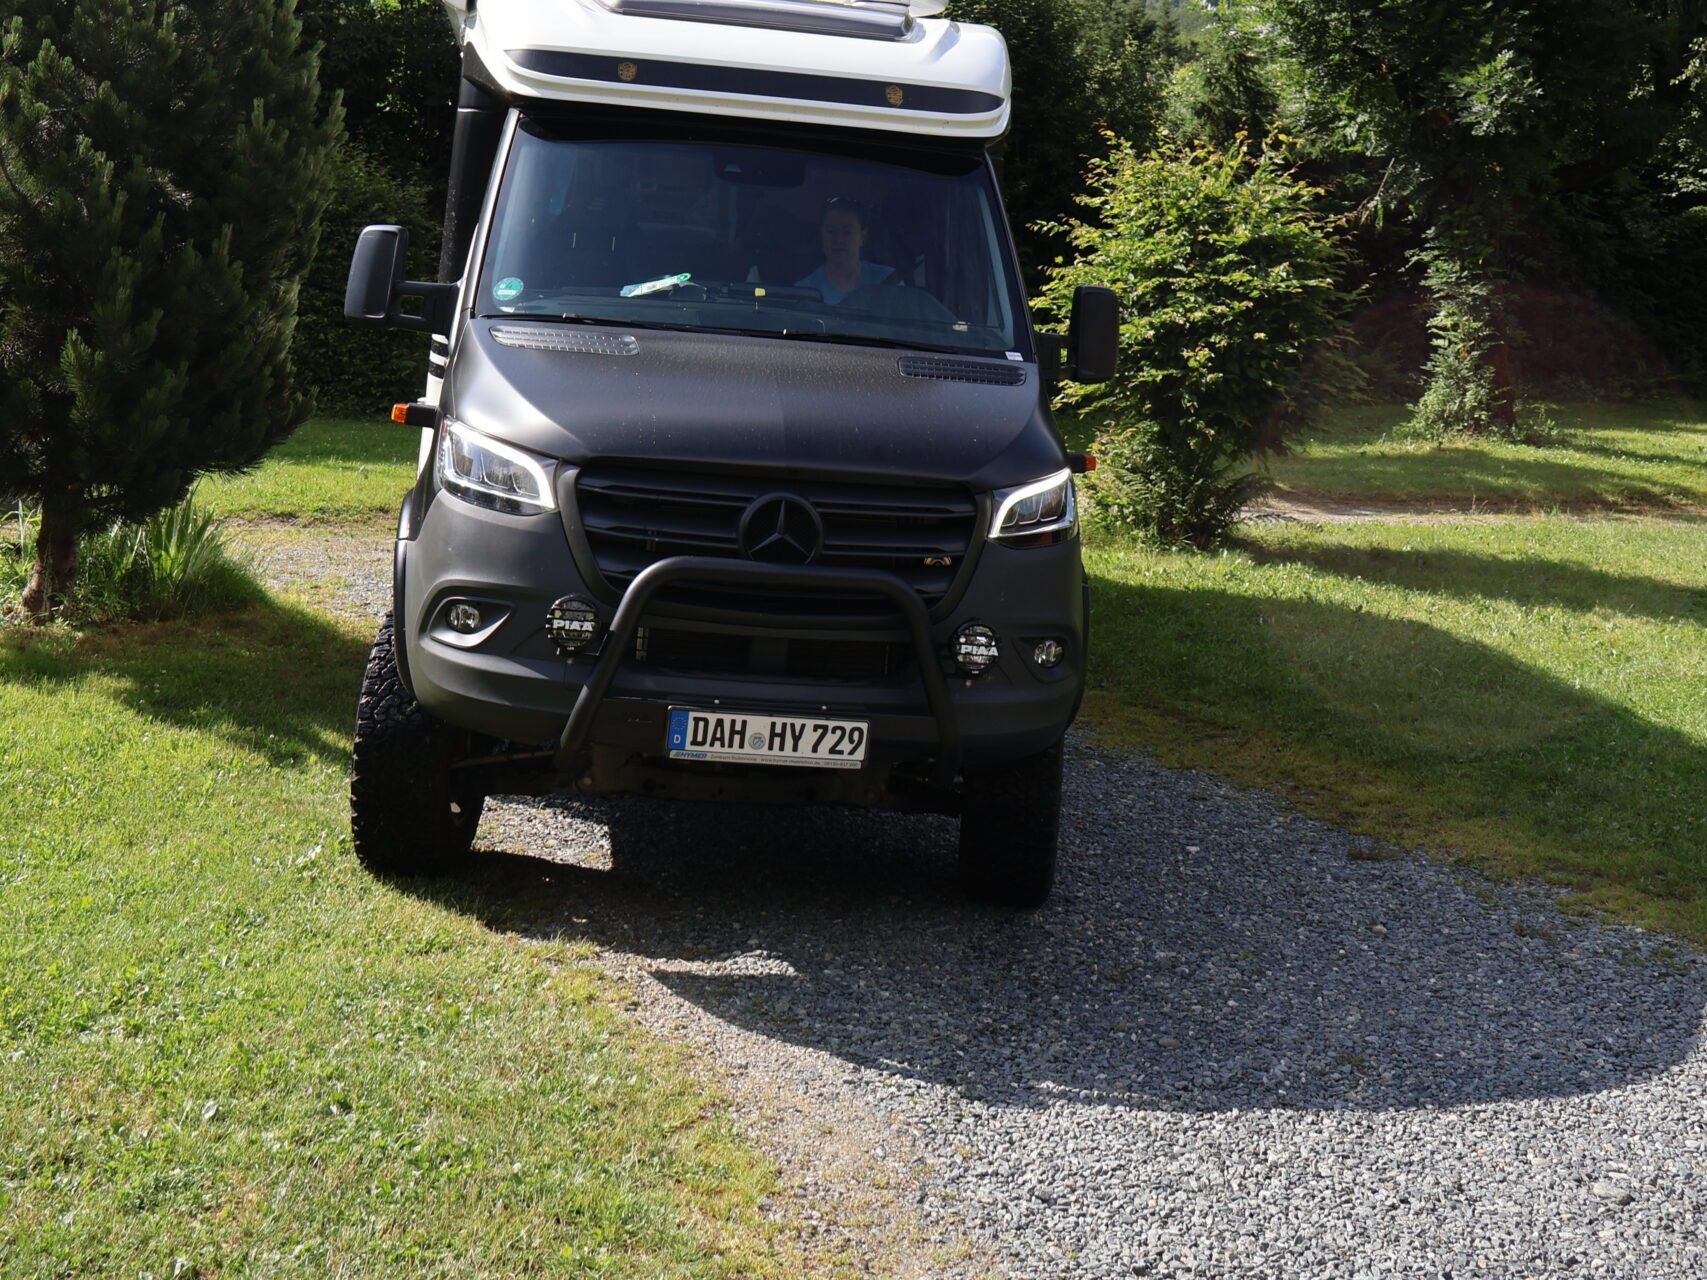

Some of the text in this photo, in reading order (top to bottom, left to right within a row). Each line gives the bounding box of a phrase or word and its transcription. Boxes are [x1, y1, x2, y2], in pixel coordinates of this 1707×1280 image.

[553, 620, 594, 631] PIAA
[961, 645, 998, 656] PIAA
[673, 734, 681, 743] D
[690, 717, 865, 756] DAH HY 729
[680, 752, 708, 760] HYMER
